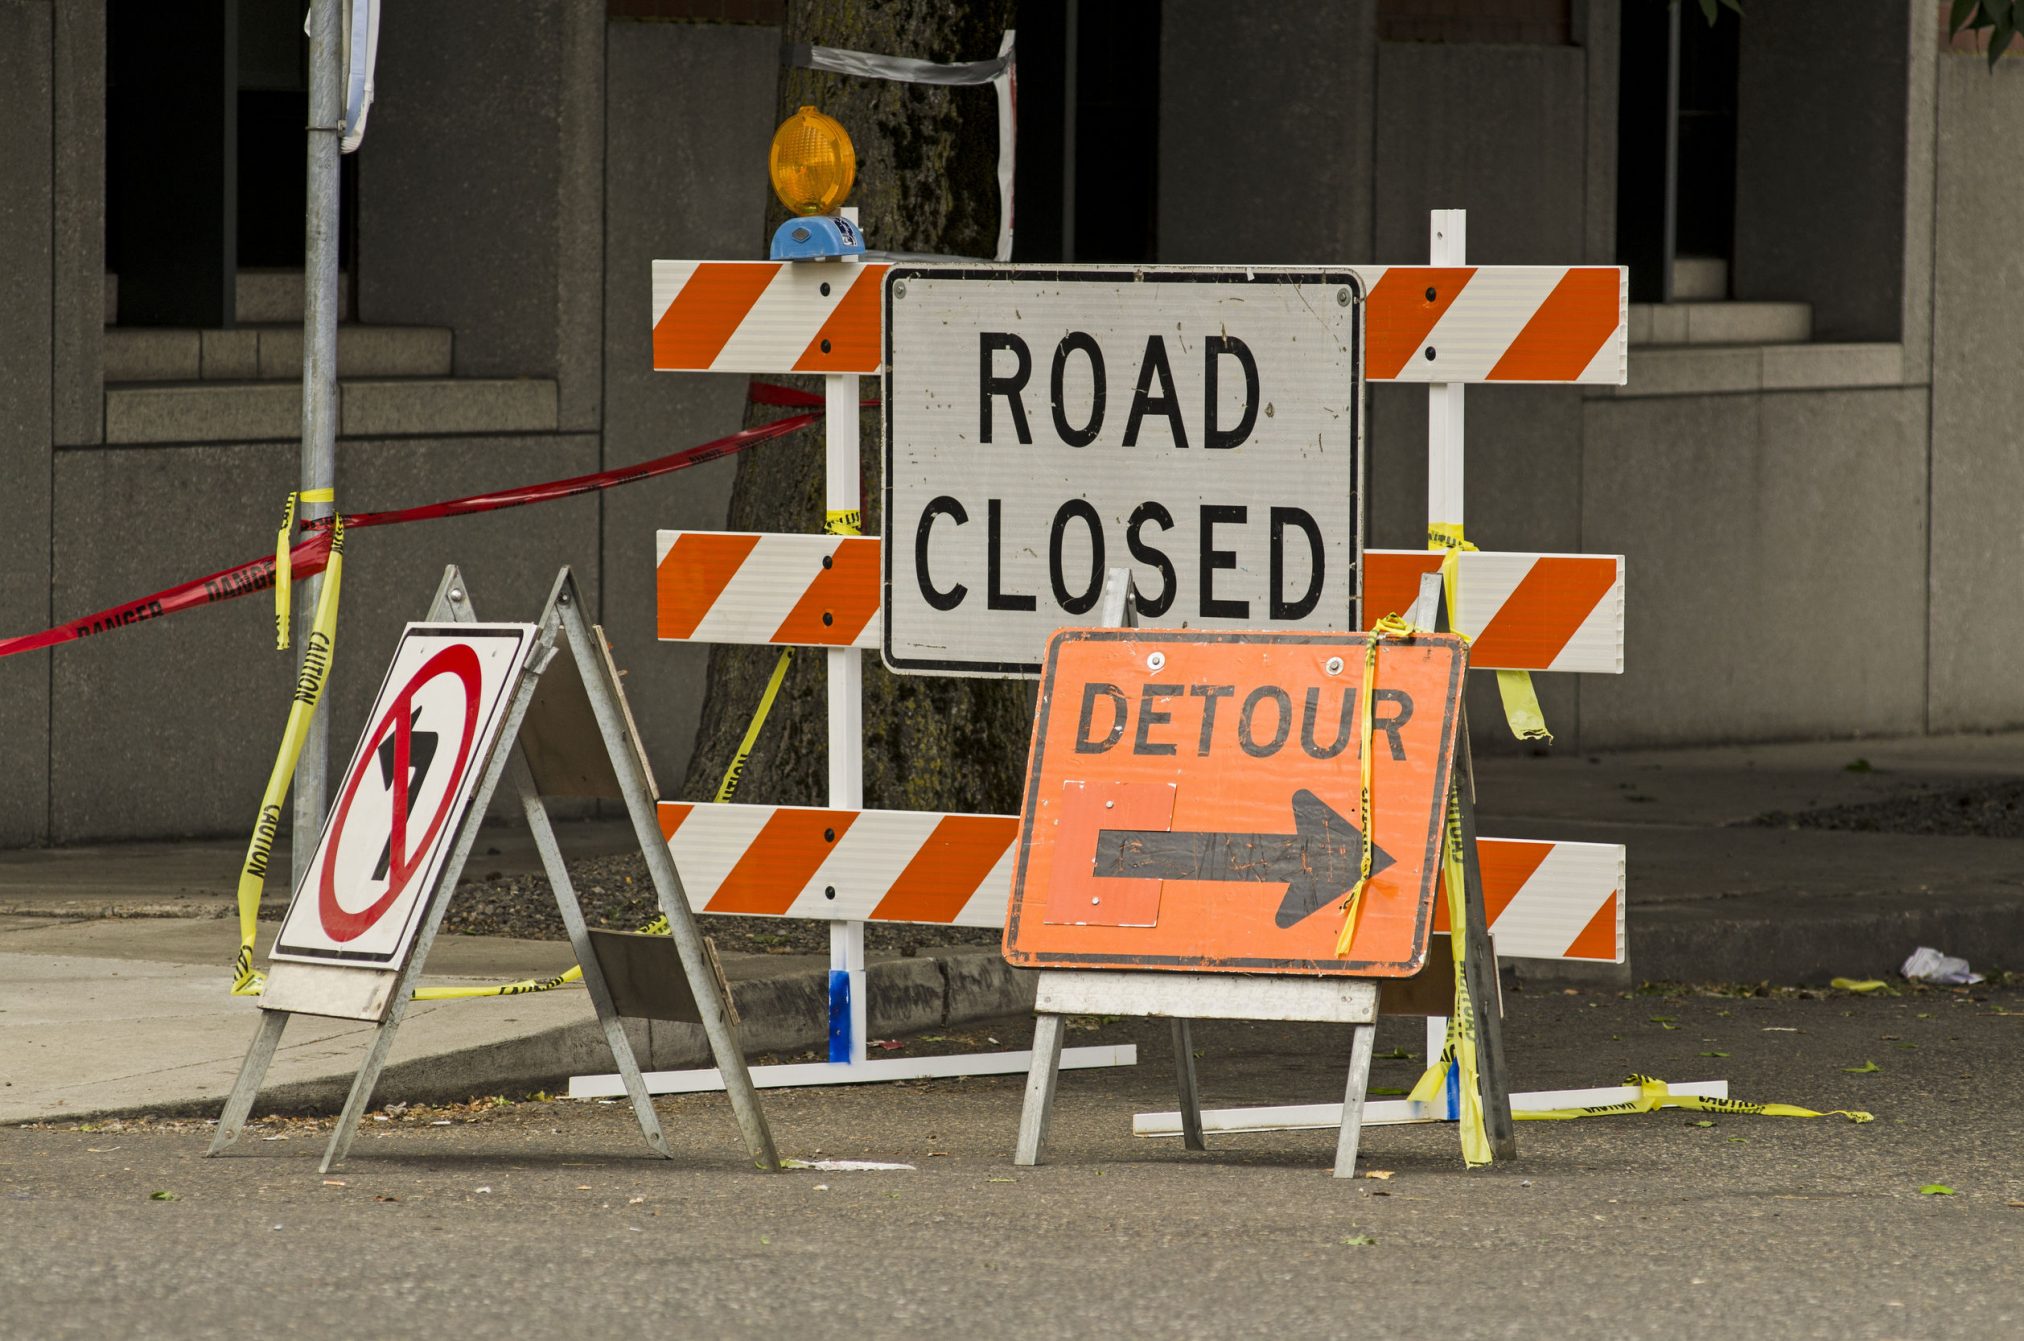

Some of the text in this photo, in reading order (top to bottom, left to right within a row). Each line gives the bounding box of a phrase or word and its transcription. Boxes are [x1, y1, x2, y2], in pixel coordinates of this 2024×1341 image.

[979, 331, 1260, 449] ROAD
[203, 561, 277, 603] DANGE
[914, 495, 1326, 621] CLOSED
[294, 632, 330, 706] CAUTION
[1074, 682, 1415, 762] DETOUR
[247, 805, 281, 880] CAUTION
